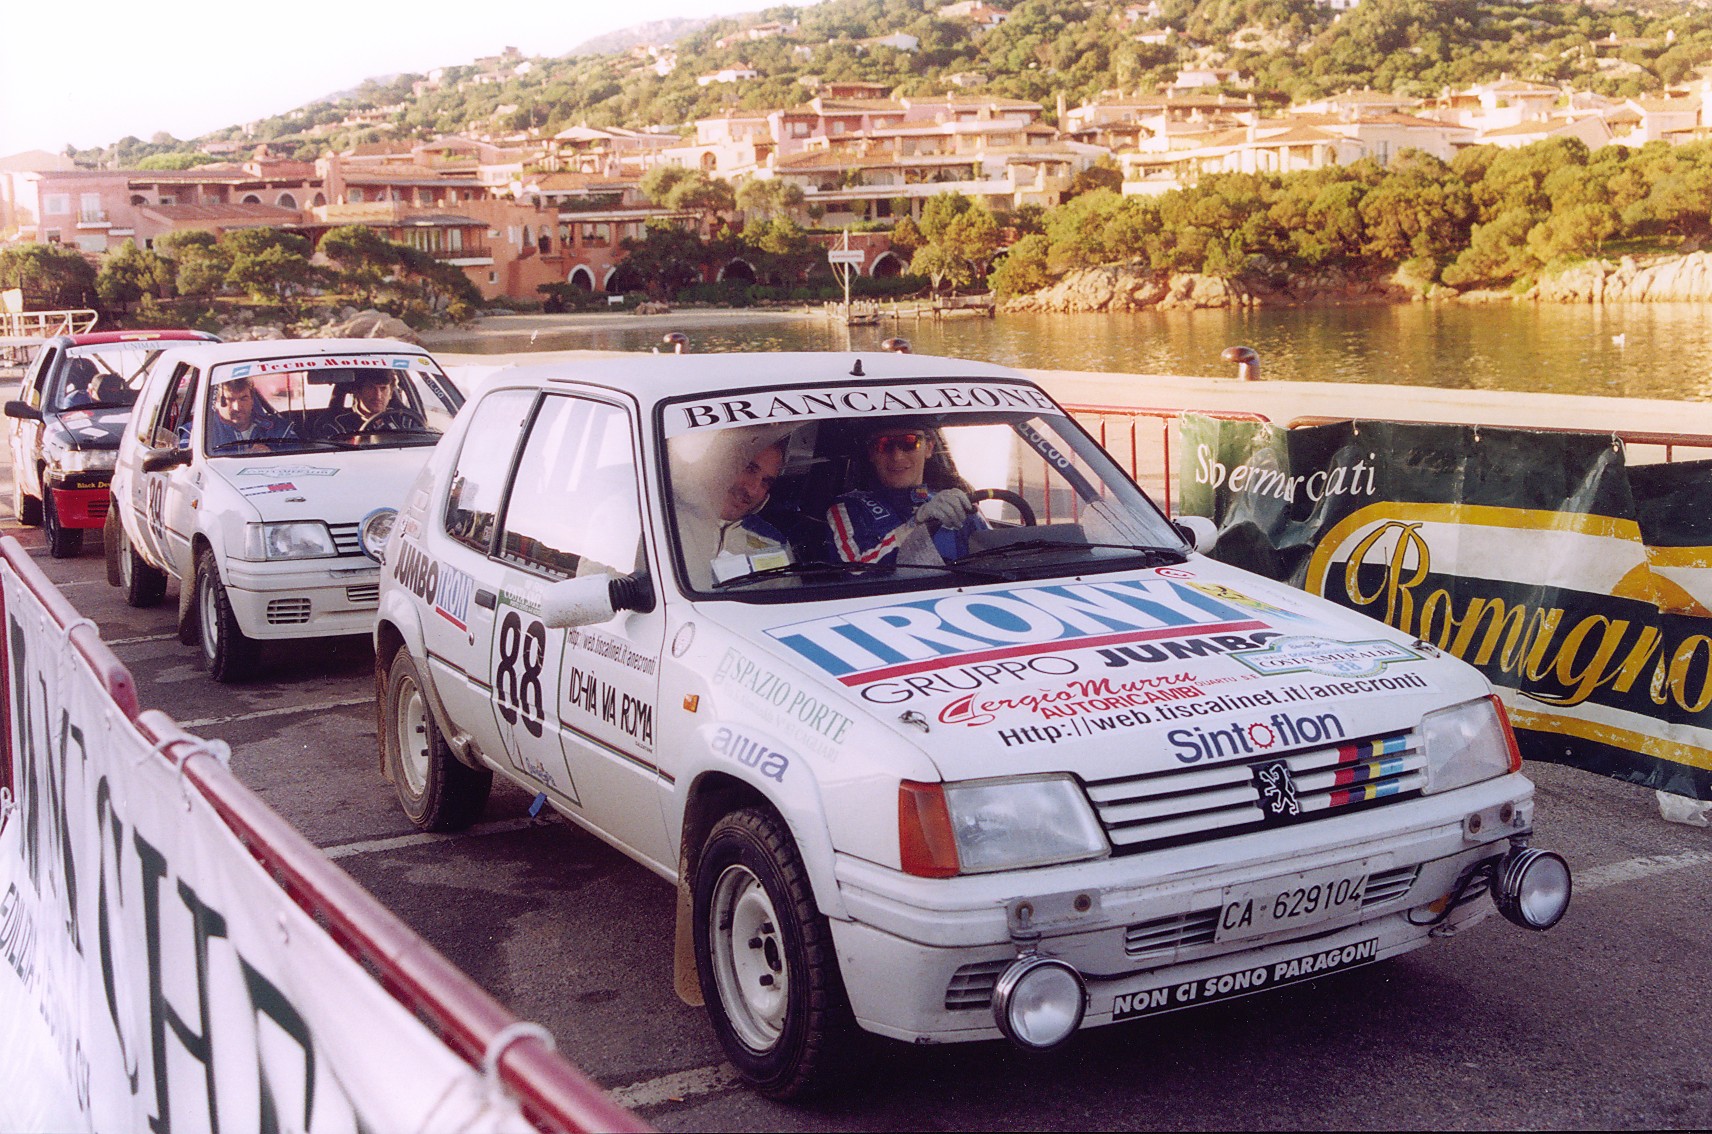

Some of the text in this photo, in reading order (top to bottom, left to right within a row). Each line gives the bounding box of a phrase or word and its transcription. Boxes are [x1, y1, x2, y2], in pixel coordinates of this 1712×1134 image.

[257, 358, 388, 372] Tecno Motori
[682, 387, 1056, 429] BRANCALEONE
[394, 539, 439, 605] JUMBO
[766, 579, 1222, 670] TRONY
[497, 611, 546, 738] 88
[861, 656, 1080, 704] GRUPPO
[1067, 672, 1197, 698] Murru
[1259, 657, 1313, 668] COSTA
[620, 693, 653, 745] ROMA
[786, 690, 854, 745] PORTE
[998, 672, 1428, 747] Http://web.tiscalinet.it/anecronti
[1040, 685, 1205, 720] AUTORICAMBI
[712, 727, 789, 783] aiwa
[1167, 713, 1345, 764] Sintoflon
[1222, 874, 1367, 930] CA 629104
[1113, 938, 1379, 1014] NON CI SONO PARAGONI
